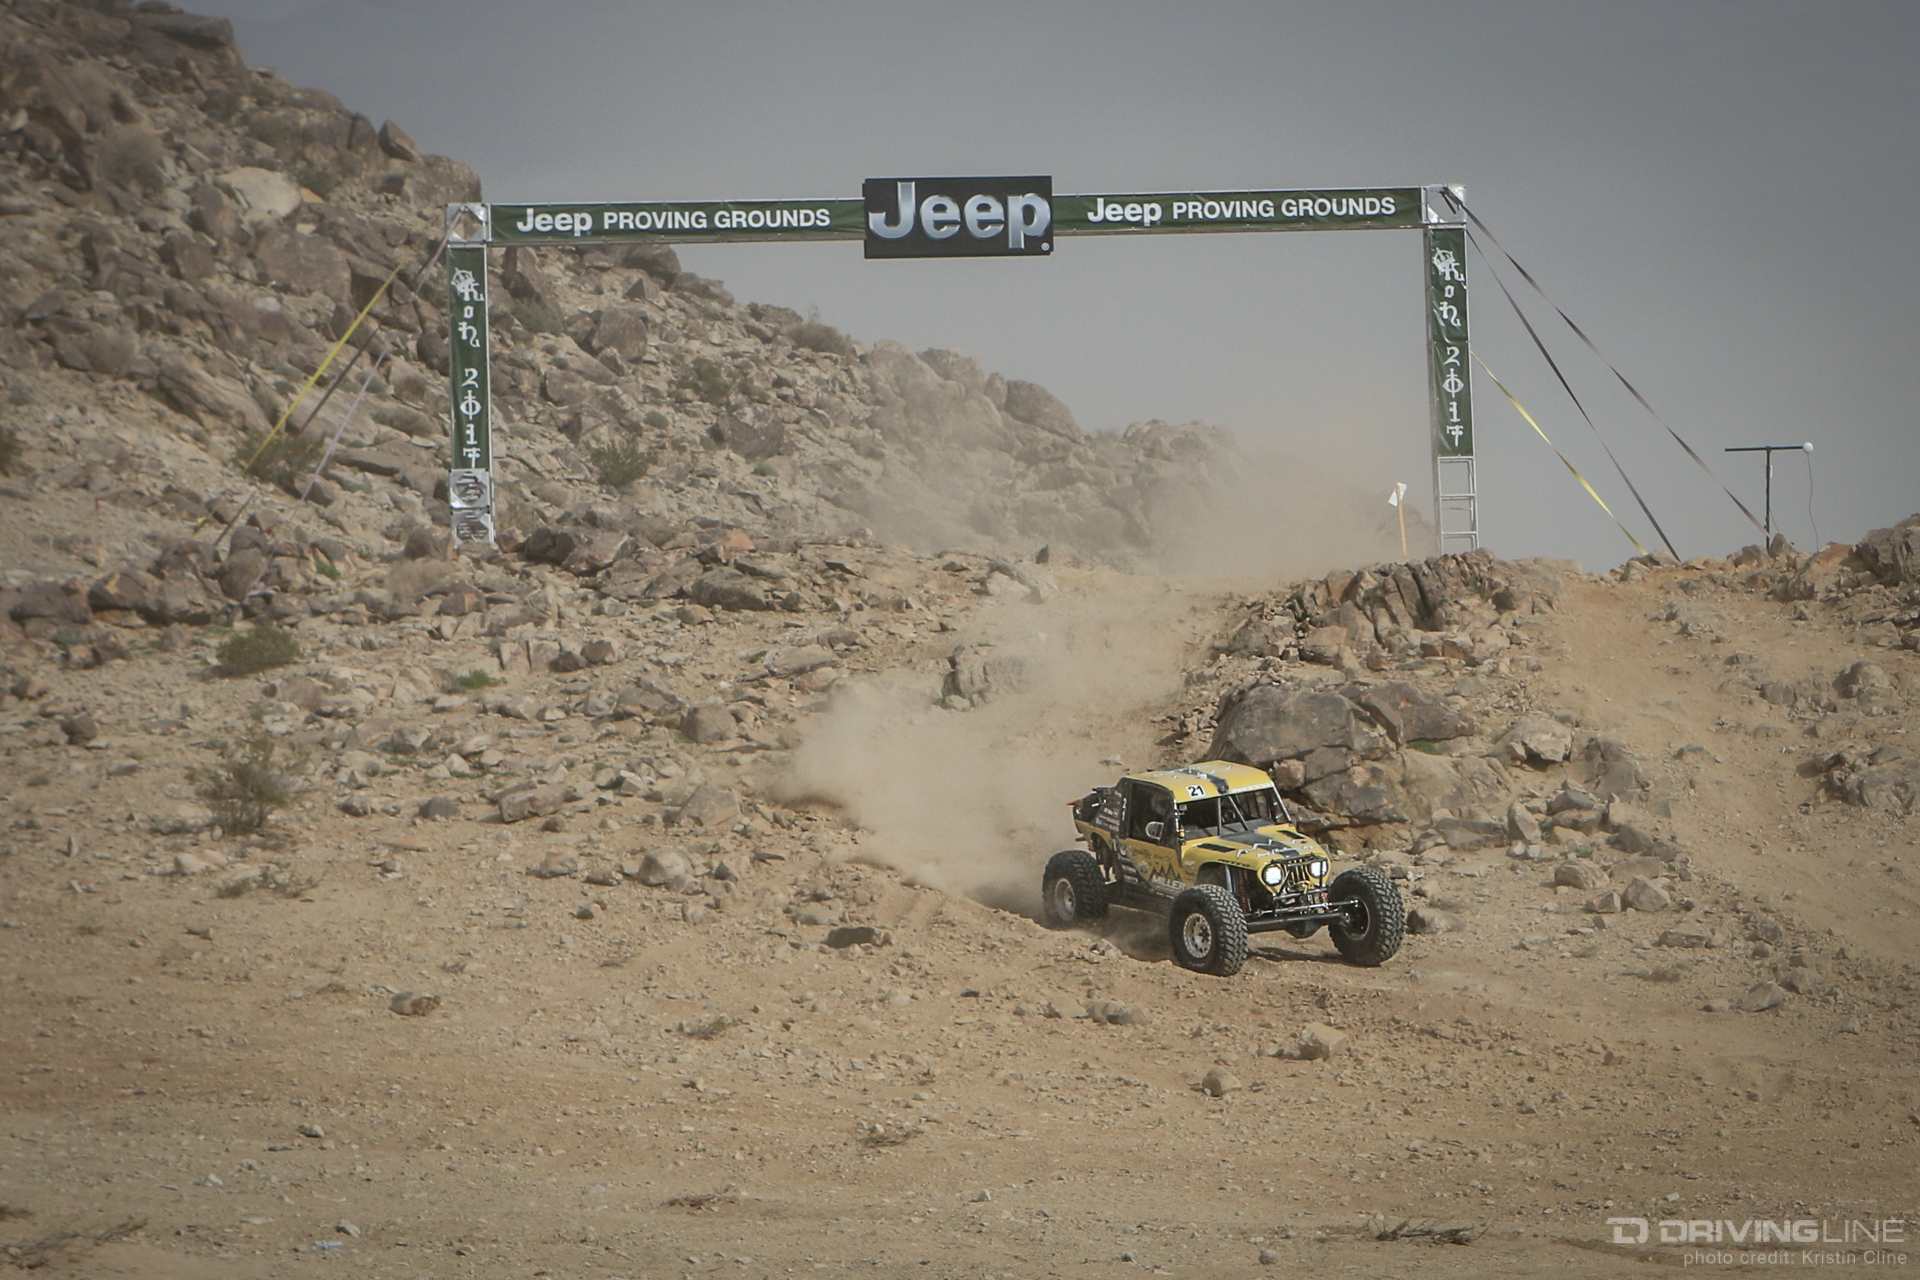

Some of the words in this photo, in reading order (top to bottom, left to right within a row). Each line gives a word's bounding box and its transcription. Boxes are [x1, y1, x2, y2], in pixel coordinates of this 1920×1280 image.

[516, 208, 593, 236] Jeep
[603, 211, 707, 230] PROVING
[714, 208, 831, 229] GROUNDS
[868, 181, 1050, 249] Jeep
[1087, 197, 1162, 226] Jeep
[1172, 200, 1275, 219] PROVING
[1281, 197, 1396, 217] GROUNDS
[1188, 785, 1205, 797] 21
[1152, 875, 1186, 891] MILLER
